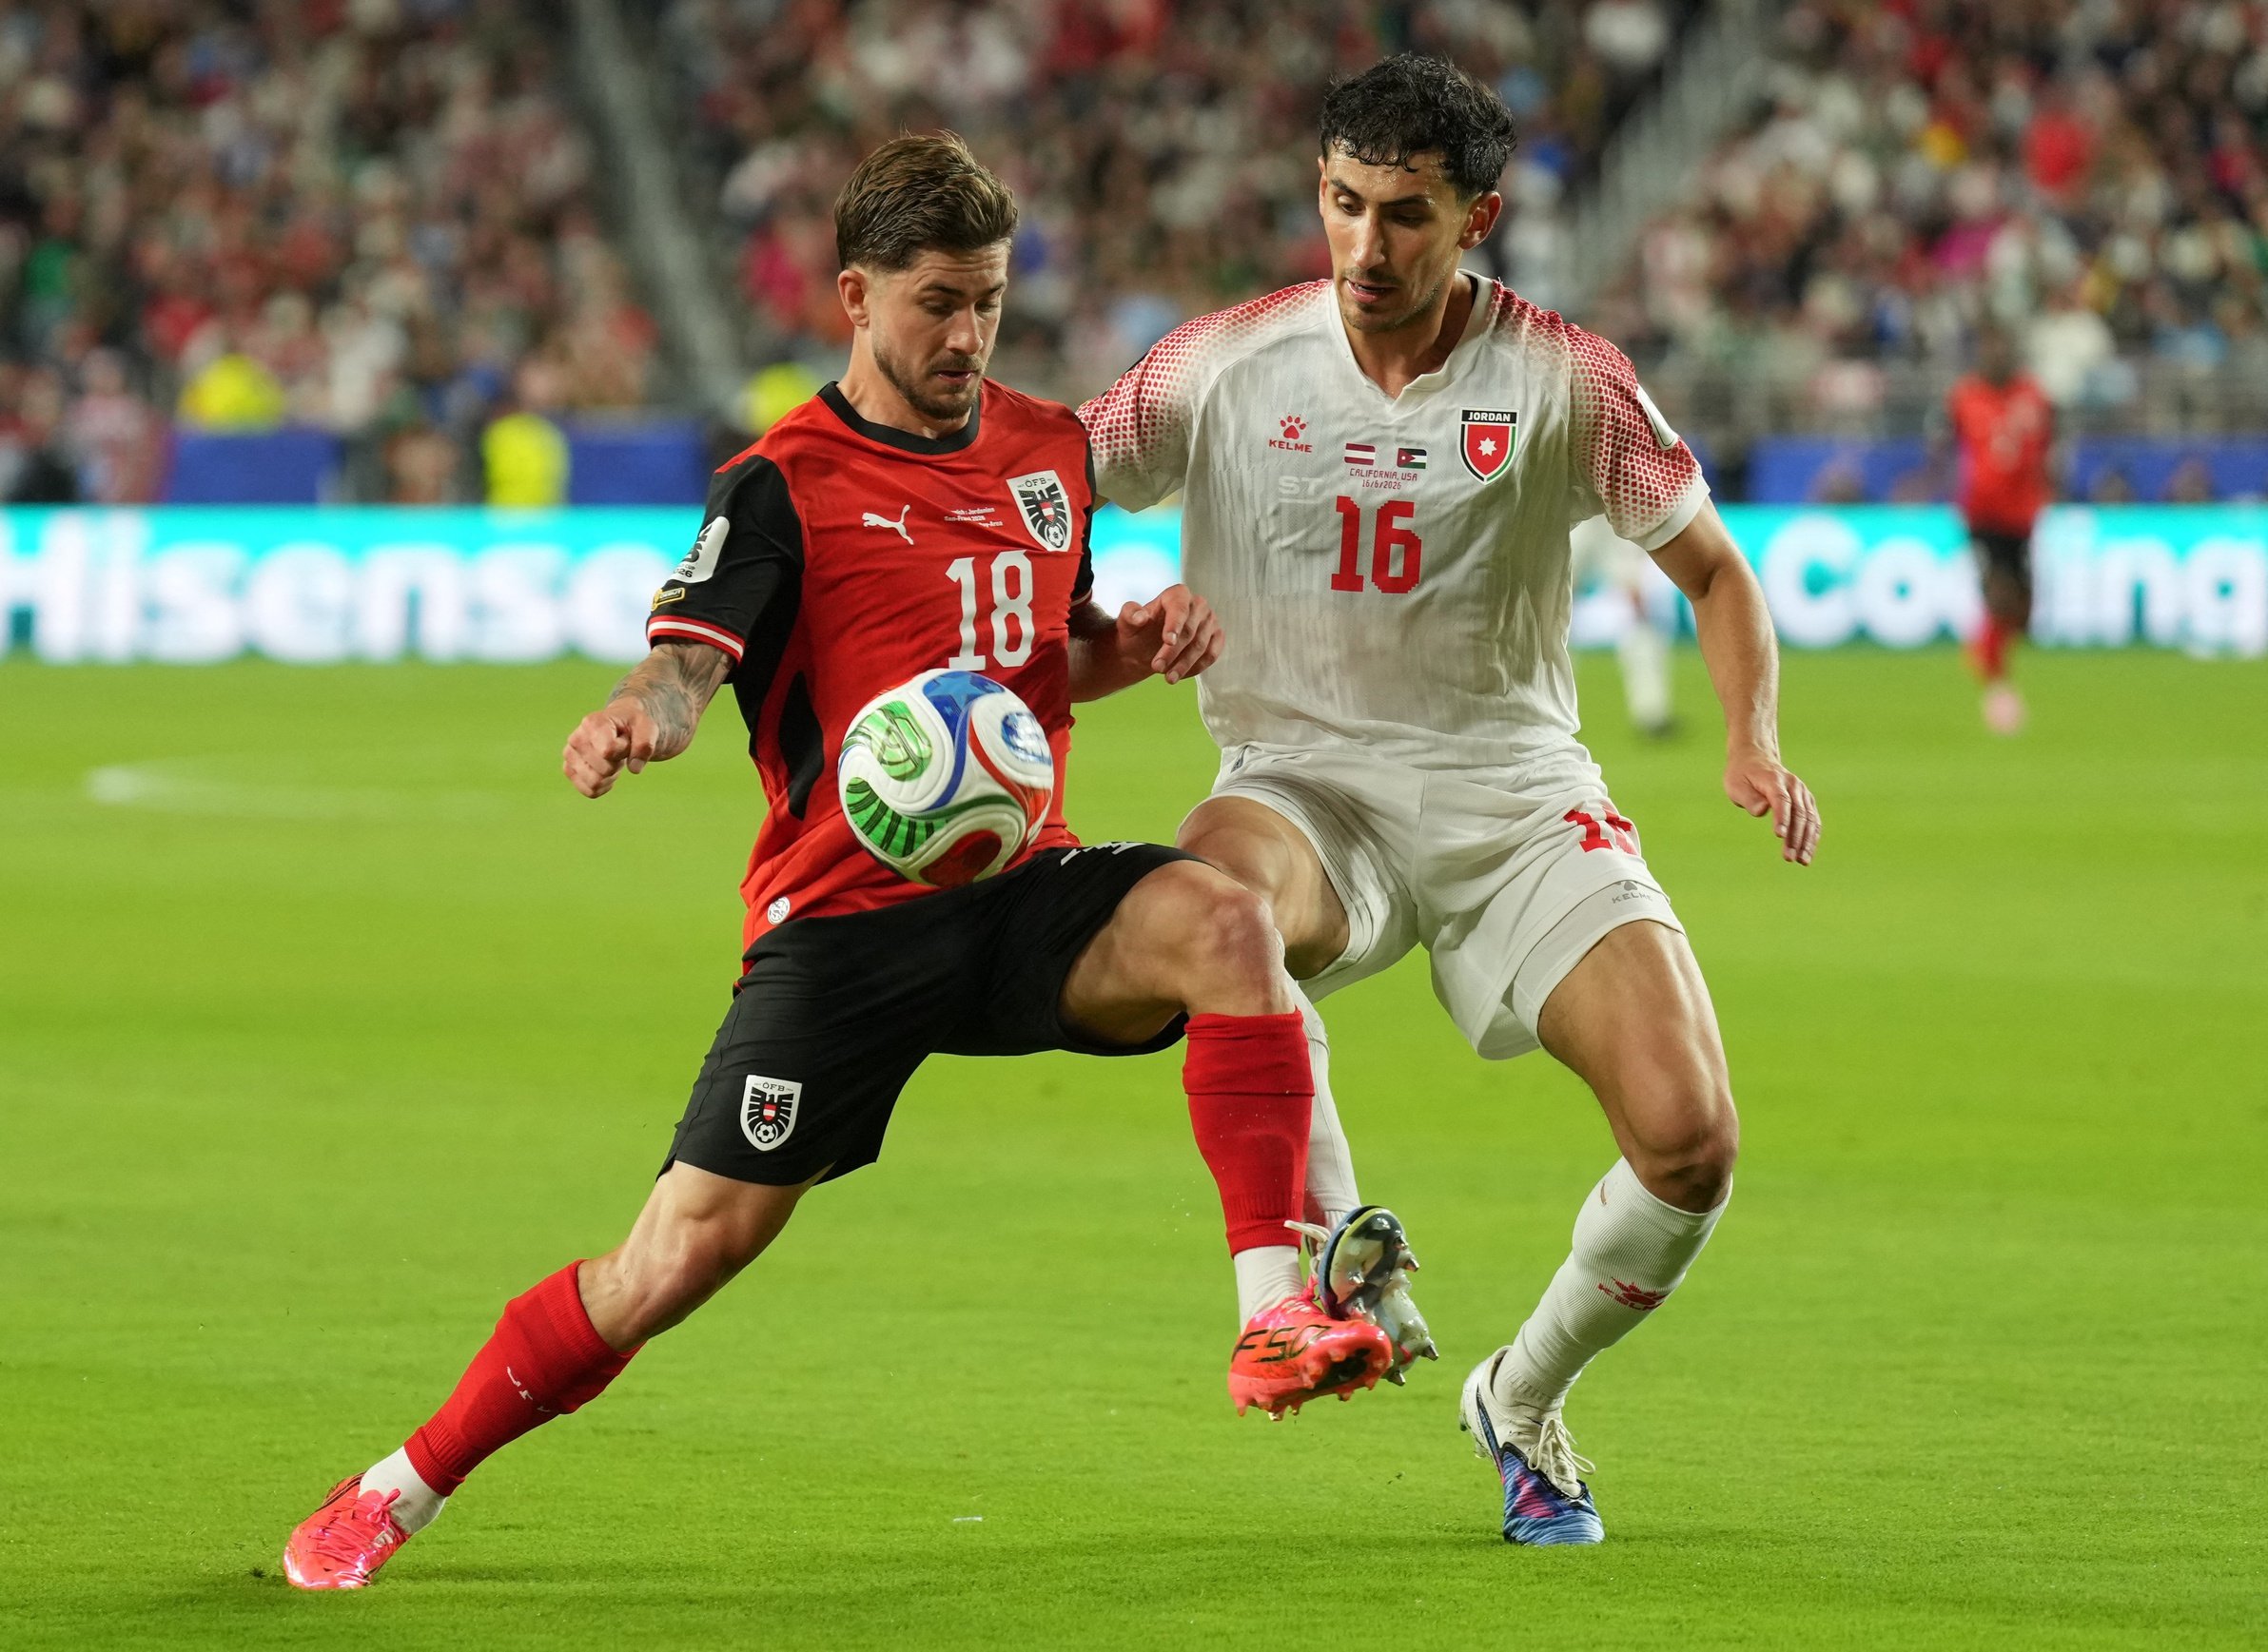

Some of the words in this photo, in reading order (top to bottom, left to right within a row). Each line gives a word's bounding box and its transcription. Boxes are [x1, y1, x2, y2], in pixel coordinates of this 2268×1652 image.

[1468, 412, 1511, 421] JORDAN
[1268, 438, 1313, 453] KELME
[1350, 468, 1399, 480] CALIFORNIA,
[1401, 473, 1418, 481] USA
[1025, 477, 1046, 487] ÖFB
[1362, 479, 1401, 490] 16/6/2026
[1331, 496, 1421, 593] 16
[0, 508, 677, 663] Hisense
[945, 550, 1035, 671] 18
[762, 1081, 785, 1092] ÖFB
